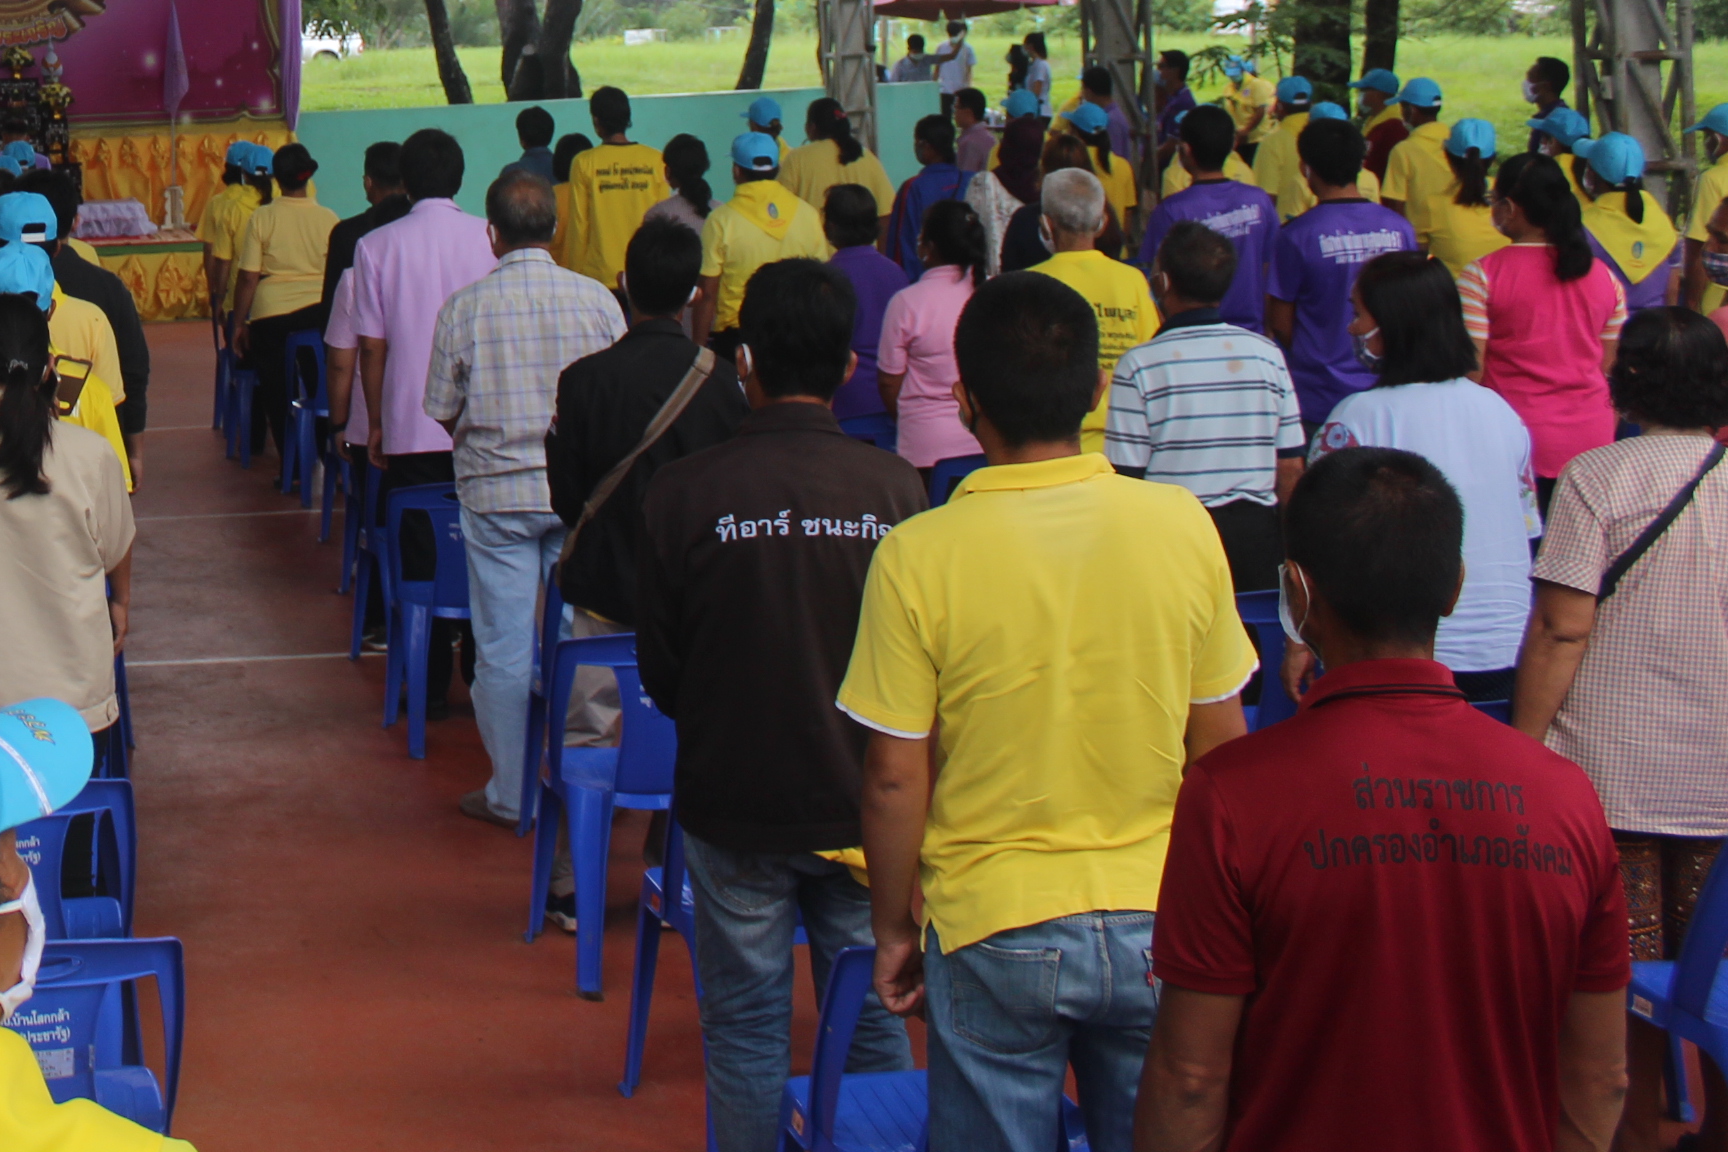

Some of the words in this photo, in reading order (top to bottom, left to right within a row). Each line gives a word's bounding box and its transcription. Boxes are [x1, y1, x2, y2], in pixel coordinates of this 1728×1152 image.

[715, 509, 792, 542] ทีอาร์
[1352, 762, 1526, 815] ส่วนราชการ
[1304, 818, 1574, 876] ปกครองอำเภอสังคม
